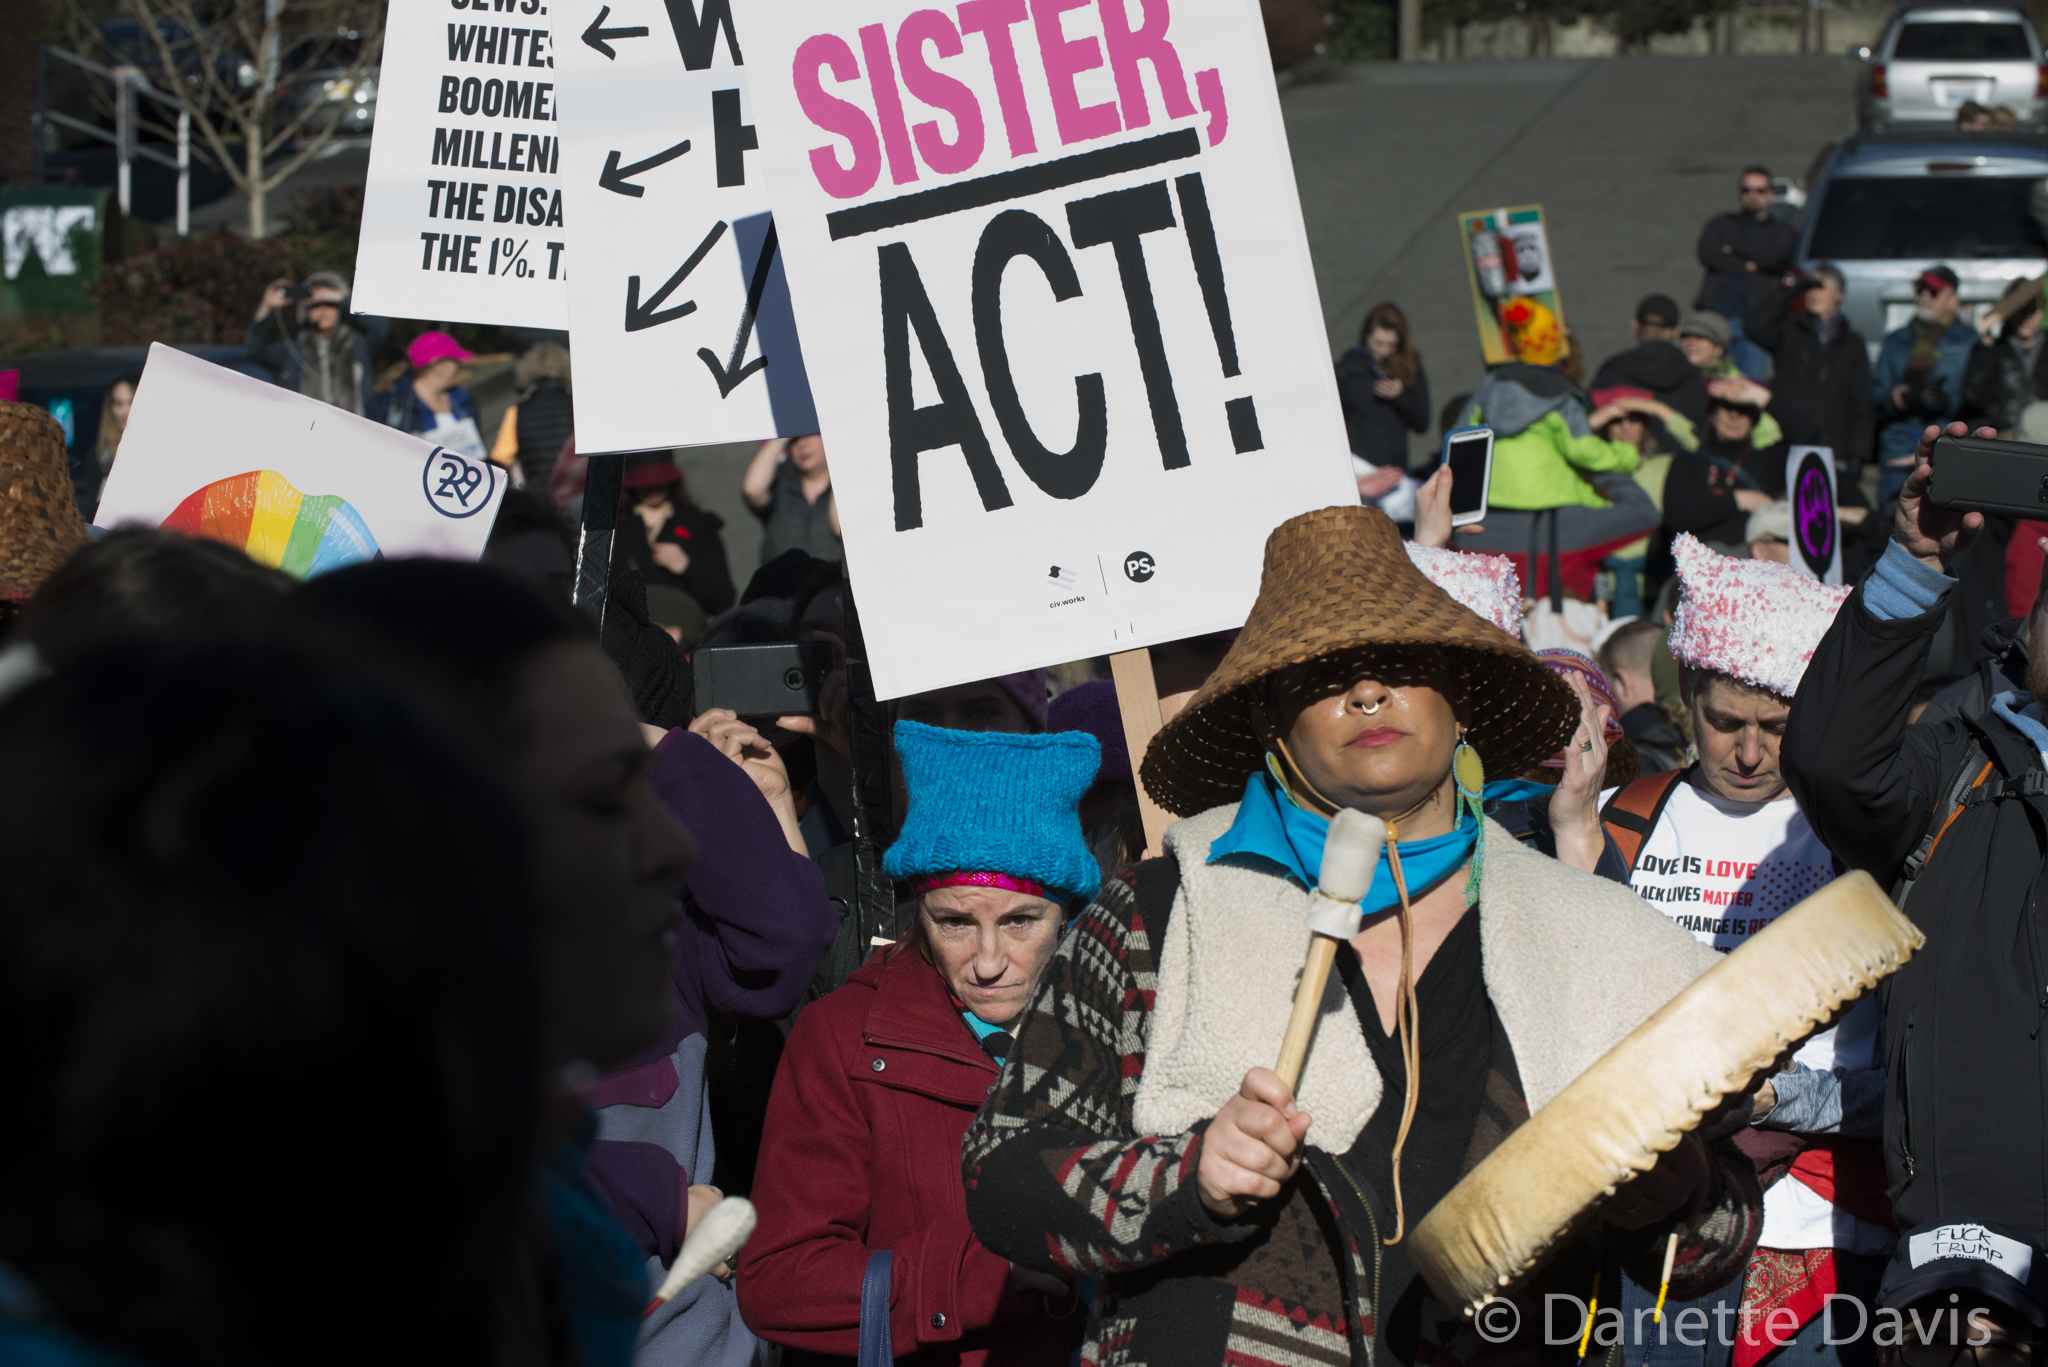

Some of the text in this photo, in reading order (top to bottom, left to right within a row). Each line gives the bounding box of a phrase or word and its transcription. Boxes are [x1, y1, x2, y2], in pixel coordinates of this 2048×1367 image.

[447, 22, 554, 70] WHITE
[438, 75, 558, 122] BOOME
[792, 0, 1229, 199] SISTER,
[427, 179, 489, 222] THE
[420, 232, 482, 274] THE
[488, 237, 535, 278] 1%.
[877, 171, 1265, 532] ACT!
[1049, 595, 1086, 609] civ.works
[1682, 855, 1702, 875] IS
[1705, 859, 1759, 880] LOVE
[1666, 886, 1702, 903] LIVES
[1702, 889, 1754, 907] MATTER
[1731, 918, 1747, 935] IS
[1931, 1242, 2004, 1261] TRUMP
[1936, 1228, 1992, 1246] FUCK
